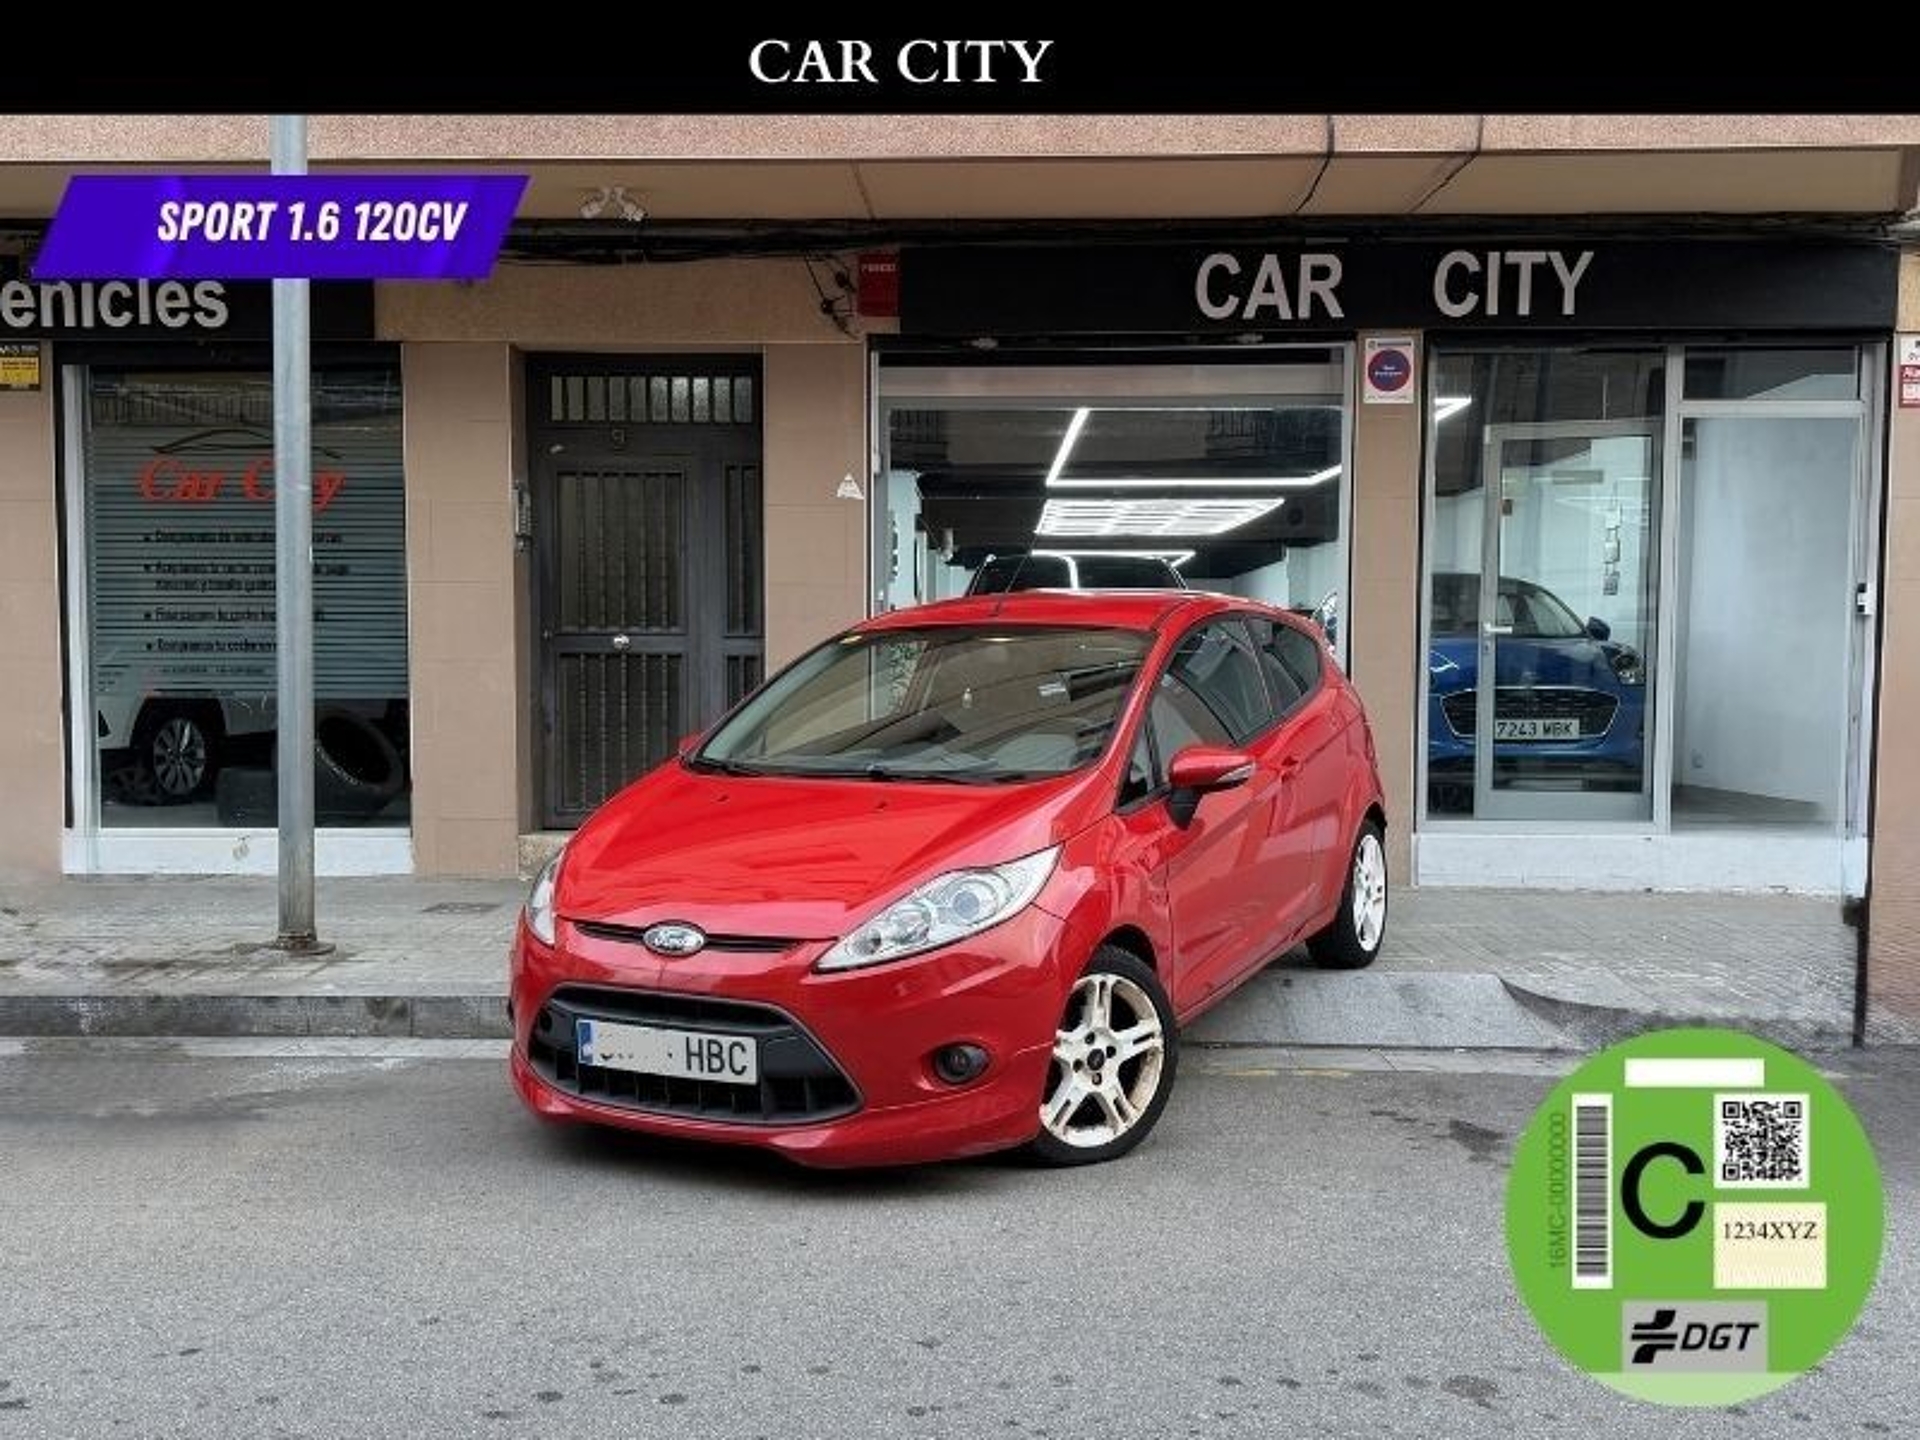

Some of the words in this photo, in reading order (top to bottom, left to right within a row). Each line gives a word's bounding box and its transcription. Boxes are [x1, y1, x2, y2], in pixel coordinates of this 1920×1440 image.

[1195, 252, 1345, 320] CAR
[1433, 250, 1594, 318] CITY
[1497, 721, 1536, 737] 7243
[685, 1036, 748, 1076] HBC
